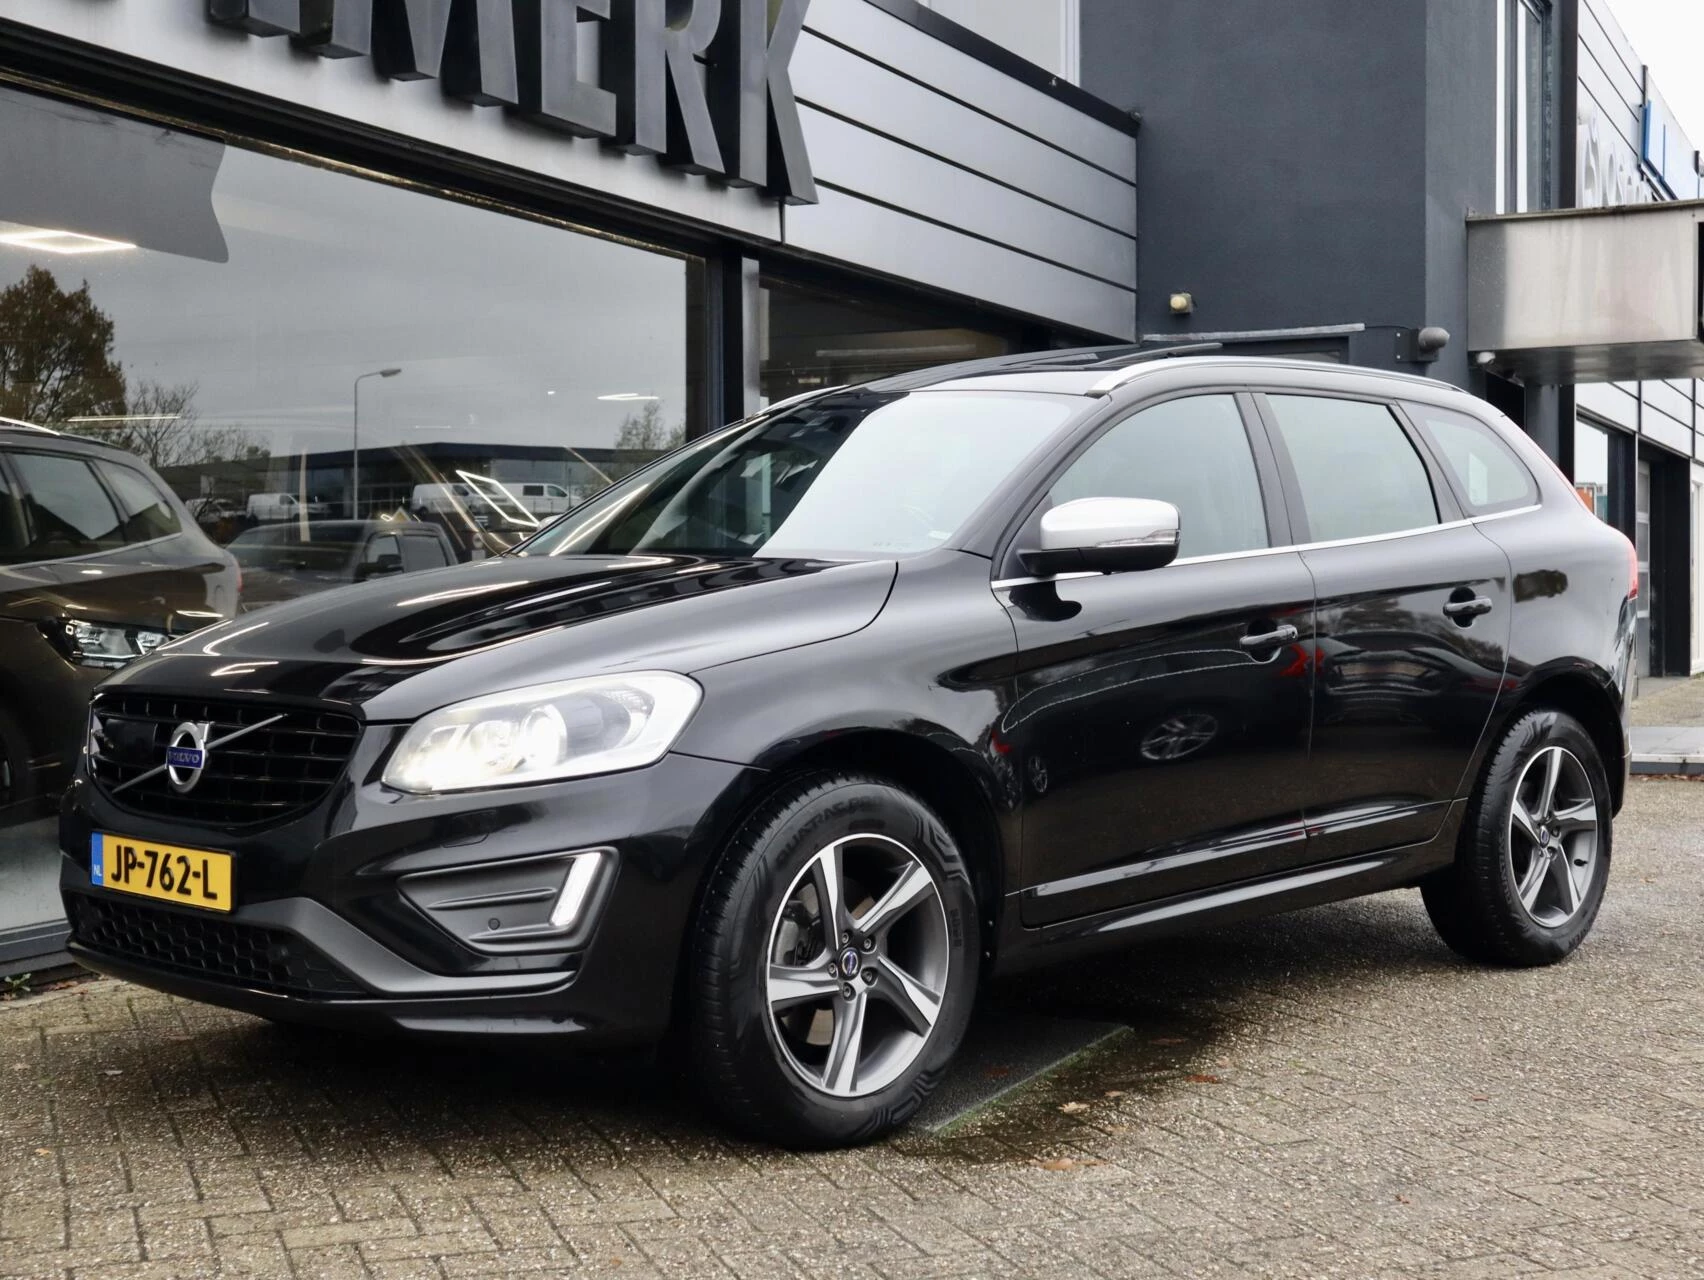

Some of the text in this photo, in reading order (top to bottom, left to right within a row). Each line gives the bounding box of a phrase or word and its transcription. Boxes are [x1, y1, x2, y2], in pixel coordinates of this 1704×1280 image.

[208, 0, 819, 206] ERK
[168, 750, 200, 764] VOLVO
[93, 845, 217, 900] NL JP-762-L
